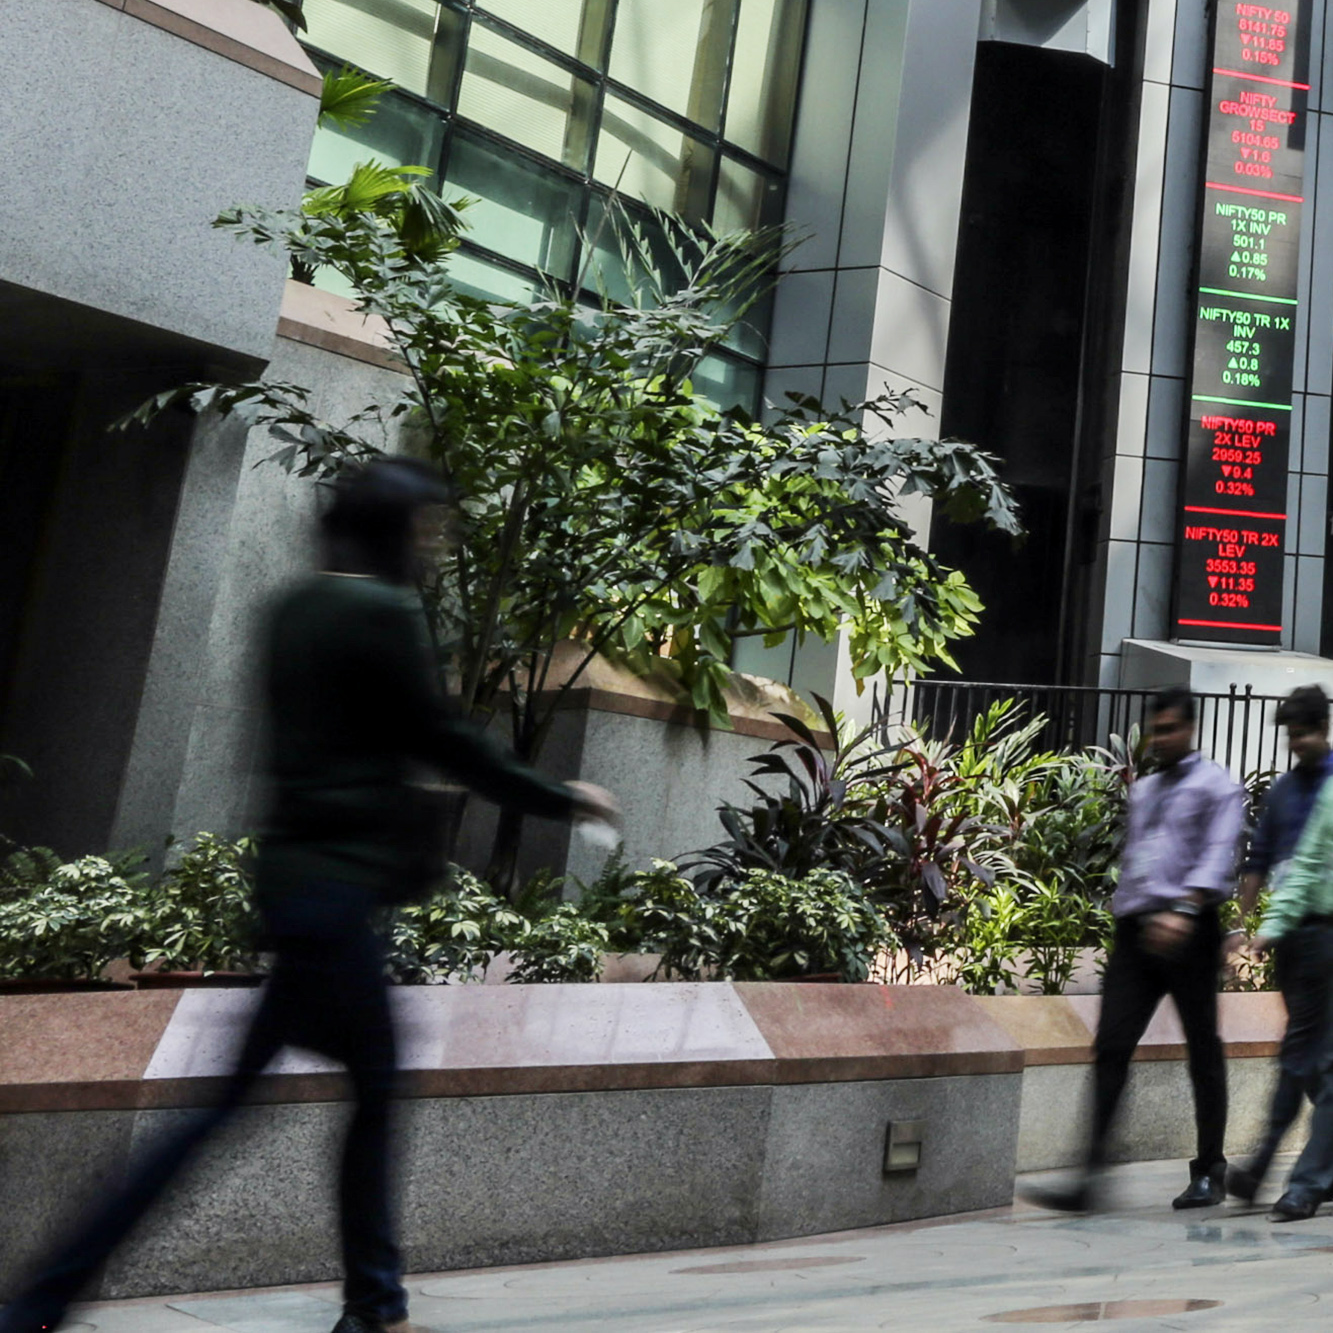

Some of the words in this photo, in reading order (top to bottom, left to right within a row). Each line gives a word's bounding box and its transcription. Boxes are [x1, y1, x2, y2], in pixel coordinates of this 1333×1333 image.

[1235, 2, 1273, 19] NIFTY
[1273, 9, 1291, 24] 50
[1251, 35, 1285, 52] 11.85
[1241, 47, 1280, 65] 0.15%
[1239, 91, 1276, 108] NIFTY
[1219, 100, 1296, 123] GROWSECT
[1249, 119, 1265, 132] 15
[1252, 149, 1271, 163] 1.6
[1233, 160, 1273, 178] 0.03%
[1215, 205, 1265, 222] NIFTY50
[1267, 212, 1287, 224] PR
[1230, 218, 1247, 231] 1X
[1248, 221, 1271, 234] INV
[1232, 233, 1266, 248] 501.1
[1240, 250, 1268, 266] 0.85
[1227, 263, 1267, 280] 0.17%
[1200, 307, 1251, 325] NIFTY50
[1252, 313, 1271, 326] TR
[1273, 317, 1290, 329] 1X
[1232, 325, 1255, 337] INV
[1224, 339, 1261, 355] 457.3
[1238, 355, 1260, 371] 0.8
[1222, 370, 1261, 387] 0.18%
[1201, 415, 1254, 433] NIFTY50
[1254, 420, 1276, 435] PR
[1214, 431, 1232, 444] 2X
[1234, 433, 1261, 447] LEV
[1212, 447, 1262, 464] 2959.25
[1215, 480, 1255, 495] 0.32%
[1184, 526, 1239, 543] NIFTY50
[1240, 530, 1260, 544] TR
[1260, 532, 1279, 546] 2X
[1218, 543, 1245, 557] LEV
[1206, 558, 1256, 575] 3553.35
[1219, 576, 1255, 591] 11.35
[1209, 591, 1249, 607] 0.32%
